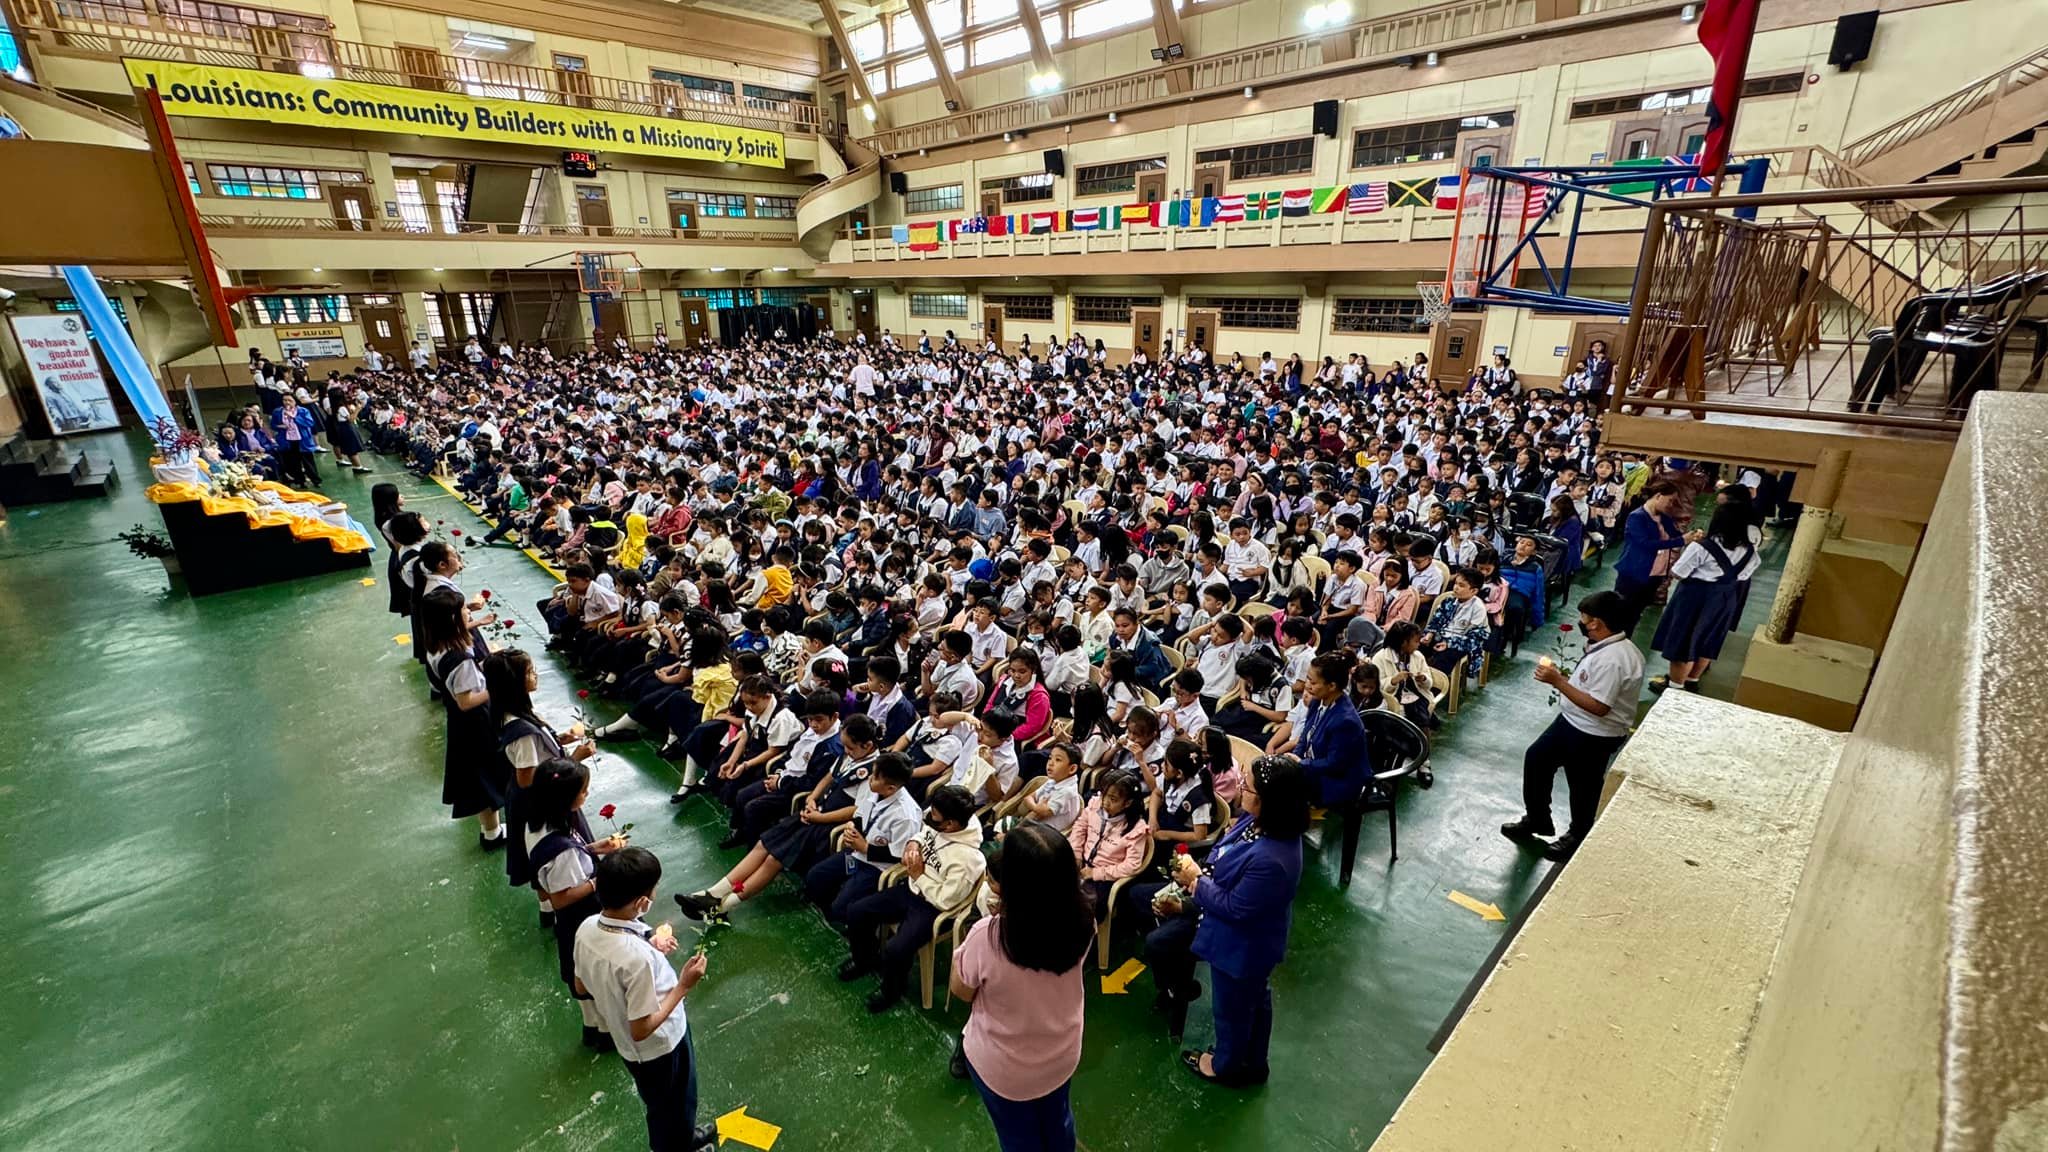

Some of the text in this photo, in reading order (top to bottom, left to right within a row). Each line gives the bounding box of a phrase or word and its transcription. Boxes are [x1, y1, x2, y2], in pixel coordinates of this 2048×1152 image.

[146, 73, 778, 159] Louisians: Community Builders with a Missionary Spirit
[44, 338, 68, 347] have
[49, 347, 90, 361] good and
[37, 359, 87, 371] beautiful
